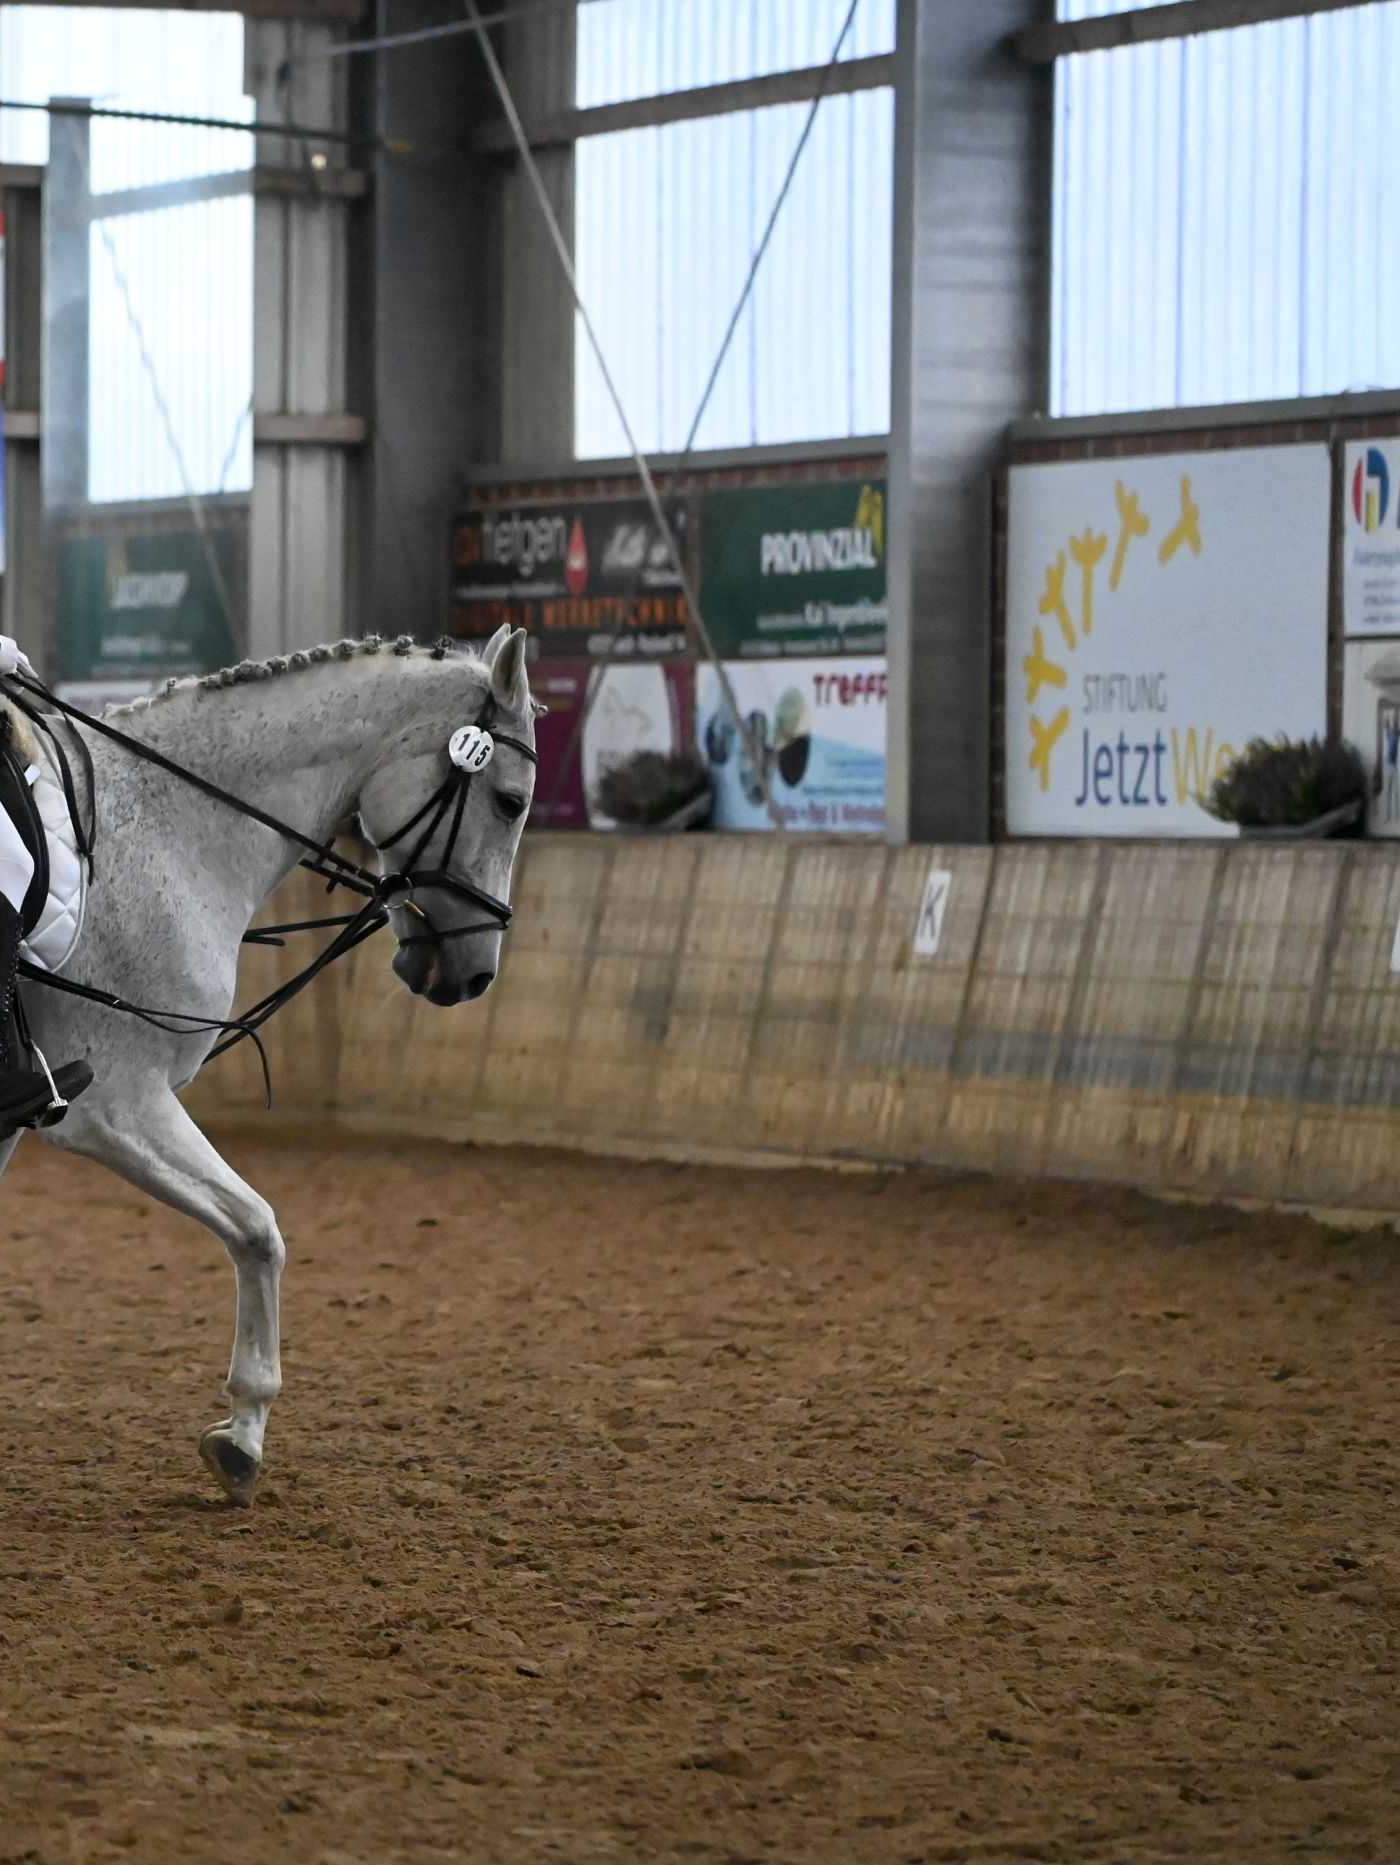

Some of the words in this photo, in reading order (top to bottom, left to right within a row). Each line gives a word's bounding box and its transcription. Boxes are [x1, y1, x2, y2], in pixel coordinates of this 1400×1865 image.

[761, 527, 877, 576] PROVINZIAL
[1082, 672, 1168, 713] STIFTUNG
[457, 732, 491, 767] 115
[1075, 726, 1255, 807] JetztWe
